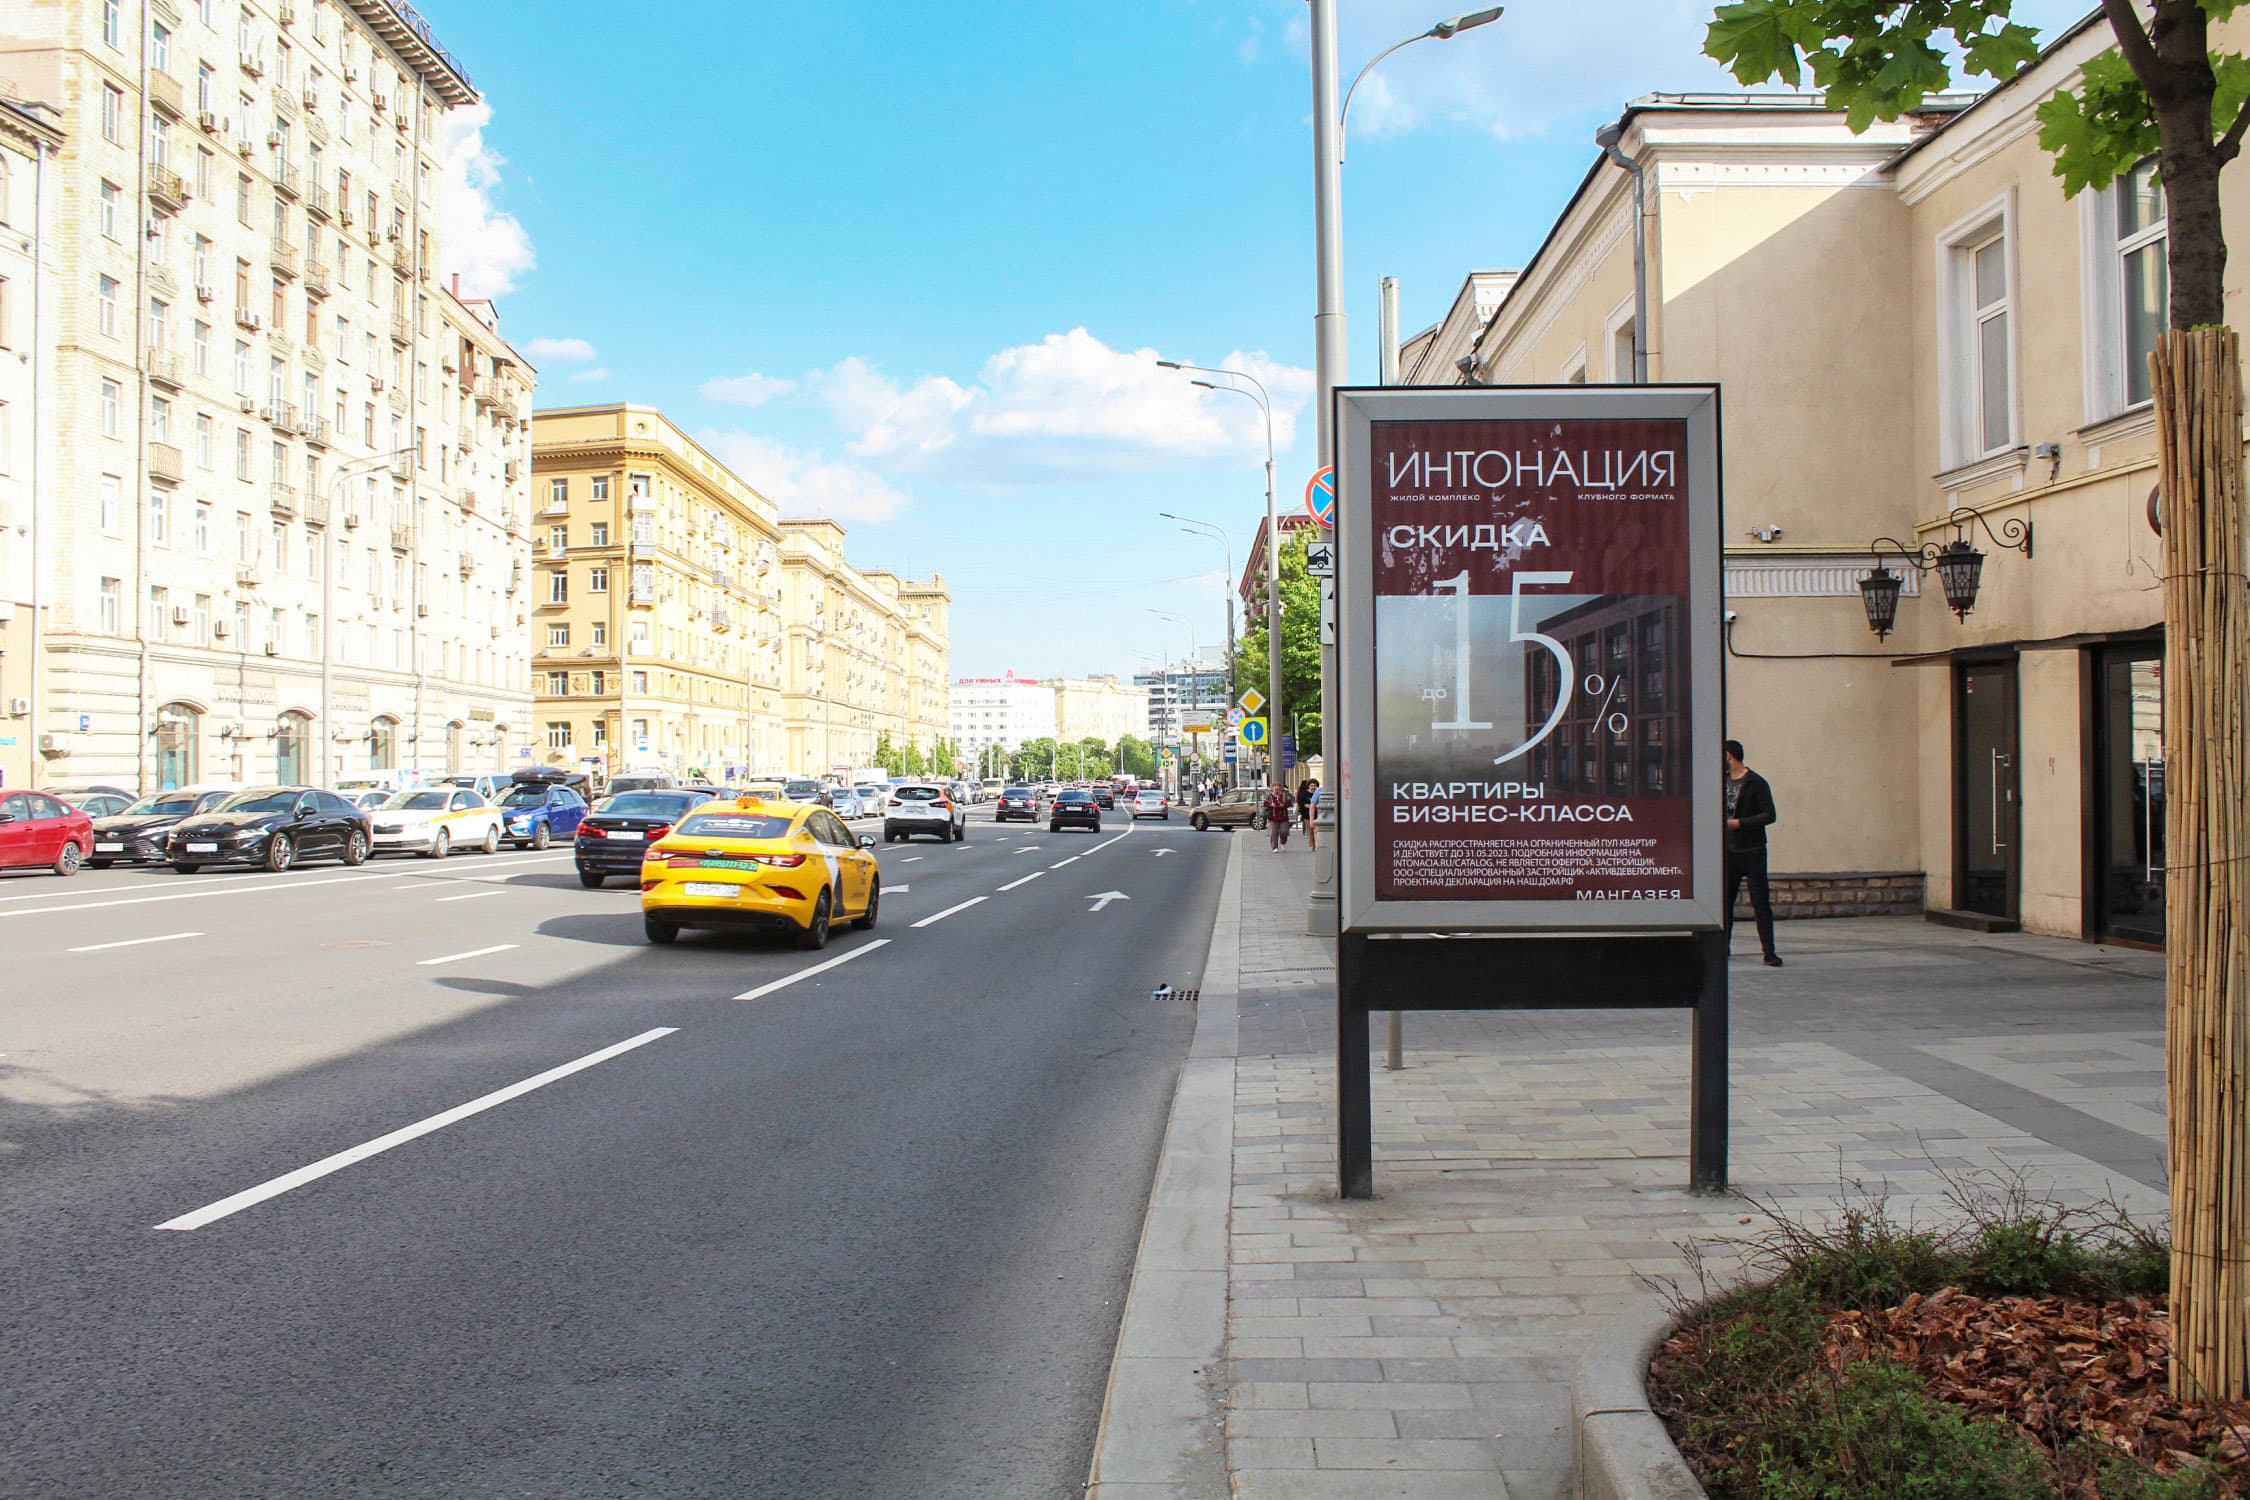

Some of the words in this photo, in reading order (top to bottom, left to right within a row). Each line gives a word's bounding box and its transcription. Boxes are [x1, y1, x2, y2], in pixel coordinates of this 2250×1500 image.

[1389, 450, 1675, 490] ИНТОНАЦИЯ
[1390, 494, 1425, 502] ЖИЛОЙ
[1389, 525, 1551, 551] СКИДКА
[1393, 782, 1544, 799] КВАРТИРЫ
[1393, 805, 1633, 822] БИЗНЕС-КЛАССА
[1392, 840, 1428, 849] СКИДКА
[1429, 839, 1515, 848] РАСПРОСТРАНЯЕТСЯ
[1516, 839, 1529, 847] НА
[1530, 838, 1600, 848] ОГРАНИЧЕННЫЙ
[1601, 839, 1618, 847] ПУЛ
[1620, 839, 1657, 847] КВАРТИР
[1401, 849, 1448, 858] ДЕЙСТВУЕТ
[1450, 849, 1463, 858] ДО
[1511, 849, 1564, 857] ПОДРОБНАЯ
[1566, 848, 1628, 857] ИНФОРМАЦИЯ
[1629, 848, 1641, 856] НА
[1496, 858, 1507, 867] НЕ
[1508, 858, 1550, 867] ЯВЛЯЕТСЯ
[1596, 857, 1655, 867] ЗАСТРОЙЩИК
[1526, 867, 1584, 876] ЗАСТРОЙЩИК
[1393, 878, 1444, 886] ПРОЕКТНАЯ
[1445, 878, 1501, 887] ДЕКЛАРАЦИЯ
[1503, 877, 1516, 885] НА
[1576, 889, 1680, 900] МАНГАЗЕЯ
